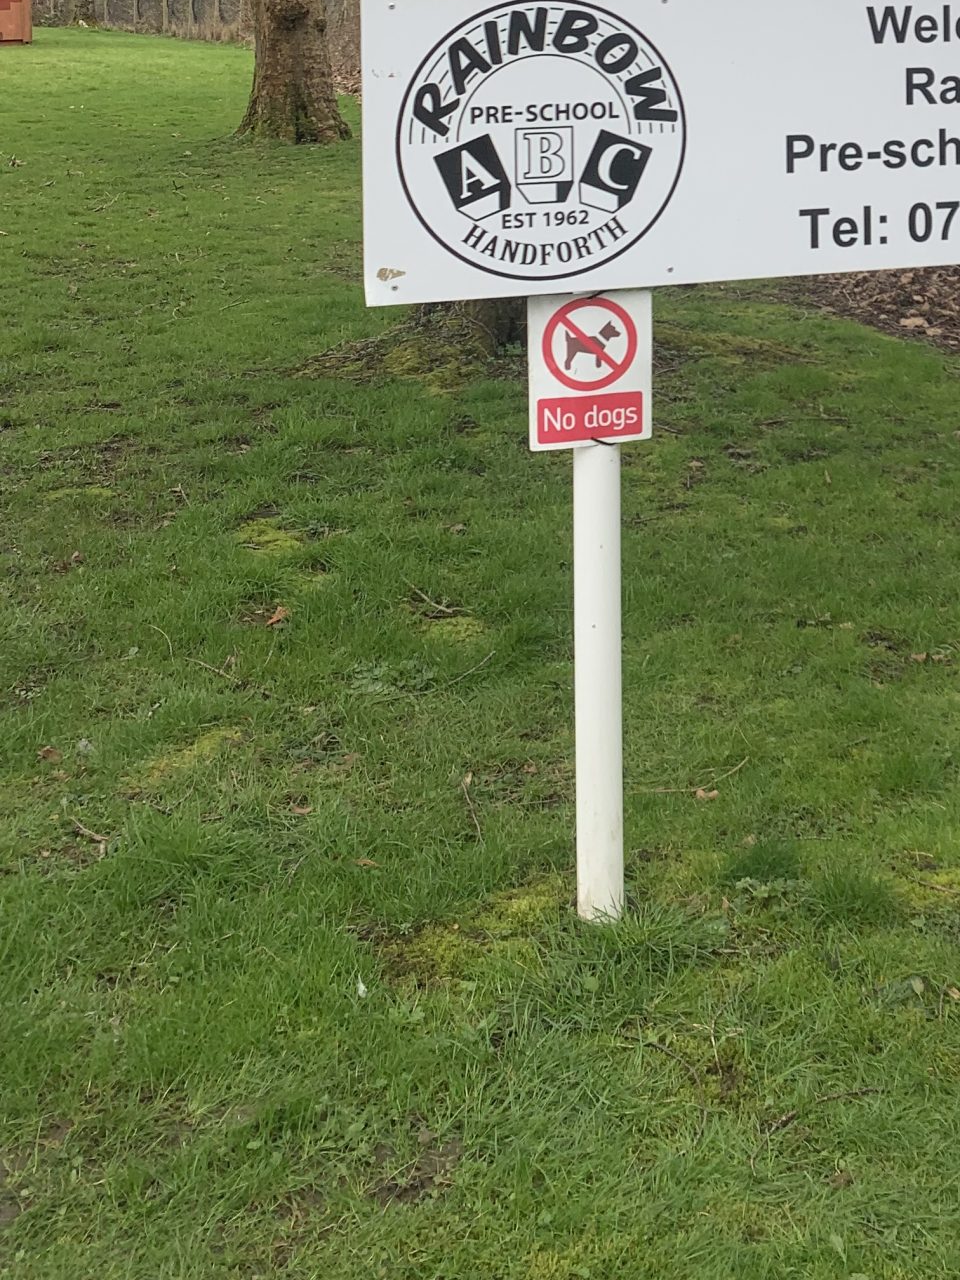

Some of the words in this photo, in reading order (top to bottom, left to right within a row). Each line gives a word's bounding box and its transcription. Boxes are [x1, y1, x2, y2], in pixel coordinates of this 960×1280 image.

[412, 6, 678, 137] RAINBOW
[470, 101, 620, 125] PRE-SCHOOL
[502, 213, 537, 230] EST
[543, 209, 590, 228] 1962
[799, 205, 888, 249] Tel:
[461, 215, 629, 266] HANDFORTH
[543, 407, 576, 432] No
[584, 404, 639, 430] dogs
